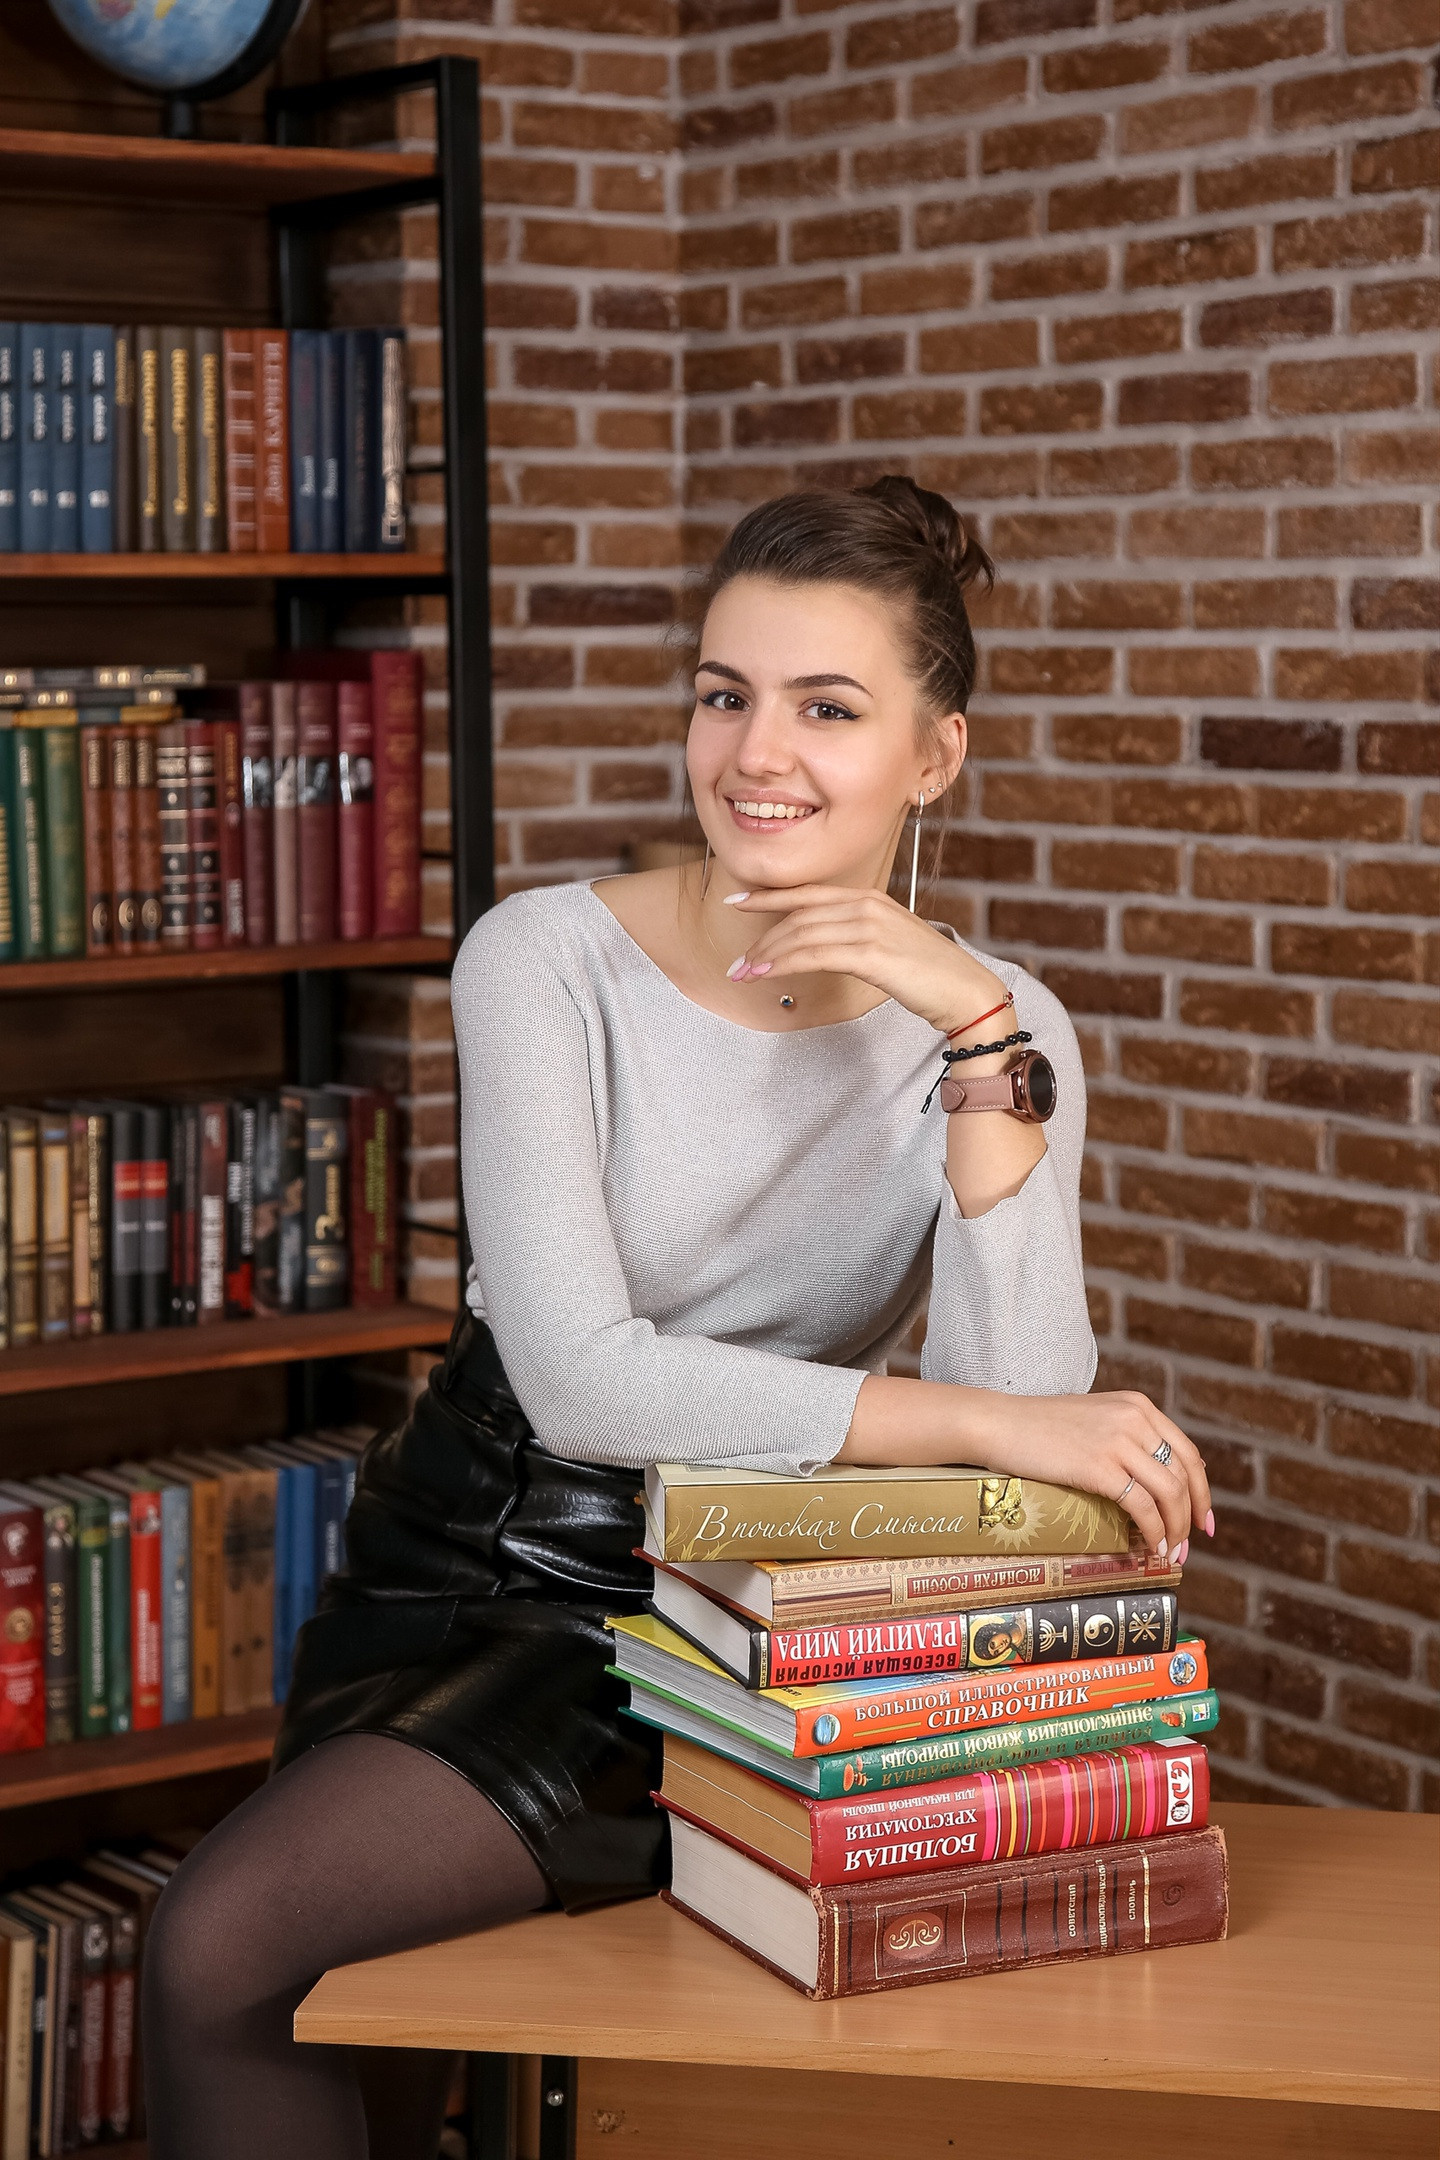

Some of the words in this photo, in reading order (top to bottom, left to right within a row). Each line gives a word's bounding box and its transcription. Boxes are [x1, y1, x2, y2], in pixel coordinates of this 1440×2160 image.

[694, 1504, 730, 1542] В
[731, 1495, 841, 1551] поисках
[849, 1502, 971, 1541] Смысла
[911, 1572, 969, 1595] РОССИИ
[972, 1566, 1042, 1585] МОНАРХИ
[775, 1629, 841, 1662] МИРА
[846, 1619, 958, 1661] РЕЛИГИЙ
[774, 1661, 856, 1684] ИСТОРИЯ
[862, 1652, 957, 1675] ВСЕОБЩАЯ
[854, 1689, 953, 1723] БОЛЬШОЙ
[957, 1655, 1157, 1703] ИЛЛЮСТРИРОВАННЫЙ
[925, 1685, 1091, 1730] СПРАВОЧНИК
[1027, 1705, 1154, 1741] ЭНЦИКЛОПЕДИЯ
[879, 1740, 960, 1770] ПРИРОДЫ
[963, 1726, 1025, 1755] ЖИВОЙ
[842, 1801, 886, 1817] ШКОЛЫ
[888, 1792, 951, 1813] НАЧАЛЬНОЙ
[953, 1787, 976, 1801] ДЛЯ
[845, 1807, 978, 1841] ХРЕСТОМАТИЯ
[843, 1832, 978, 1872] БОЛЬШАЯ
[1067, 1883, 1077, 1938] СОВЕТСКИЙ
[1127, 1879, 1137, 1921] СЛОВАРЬ
